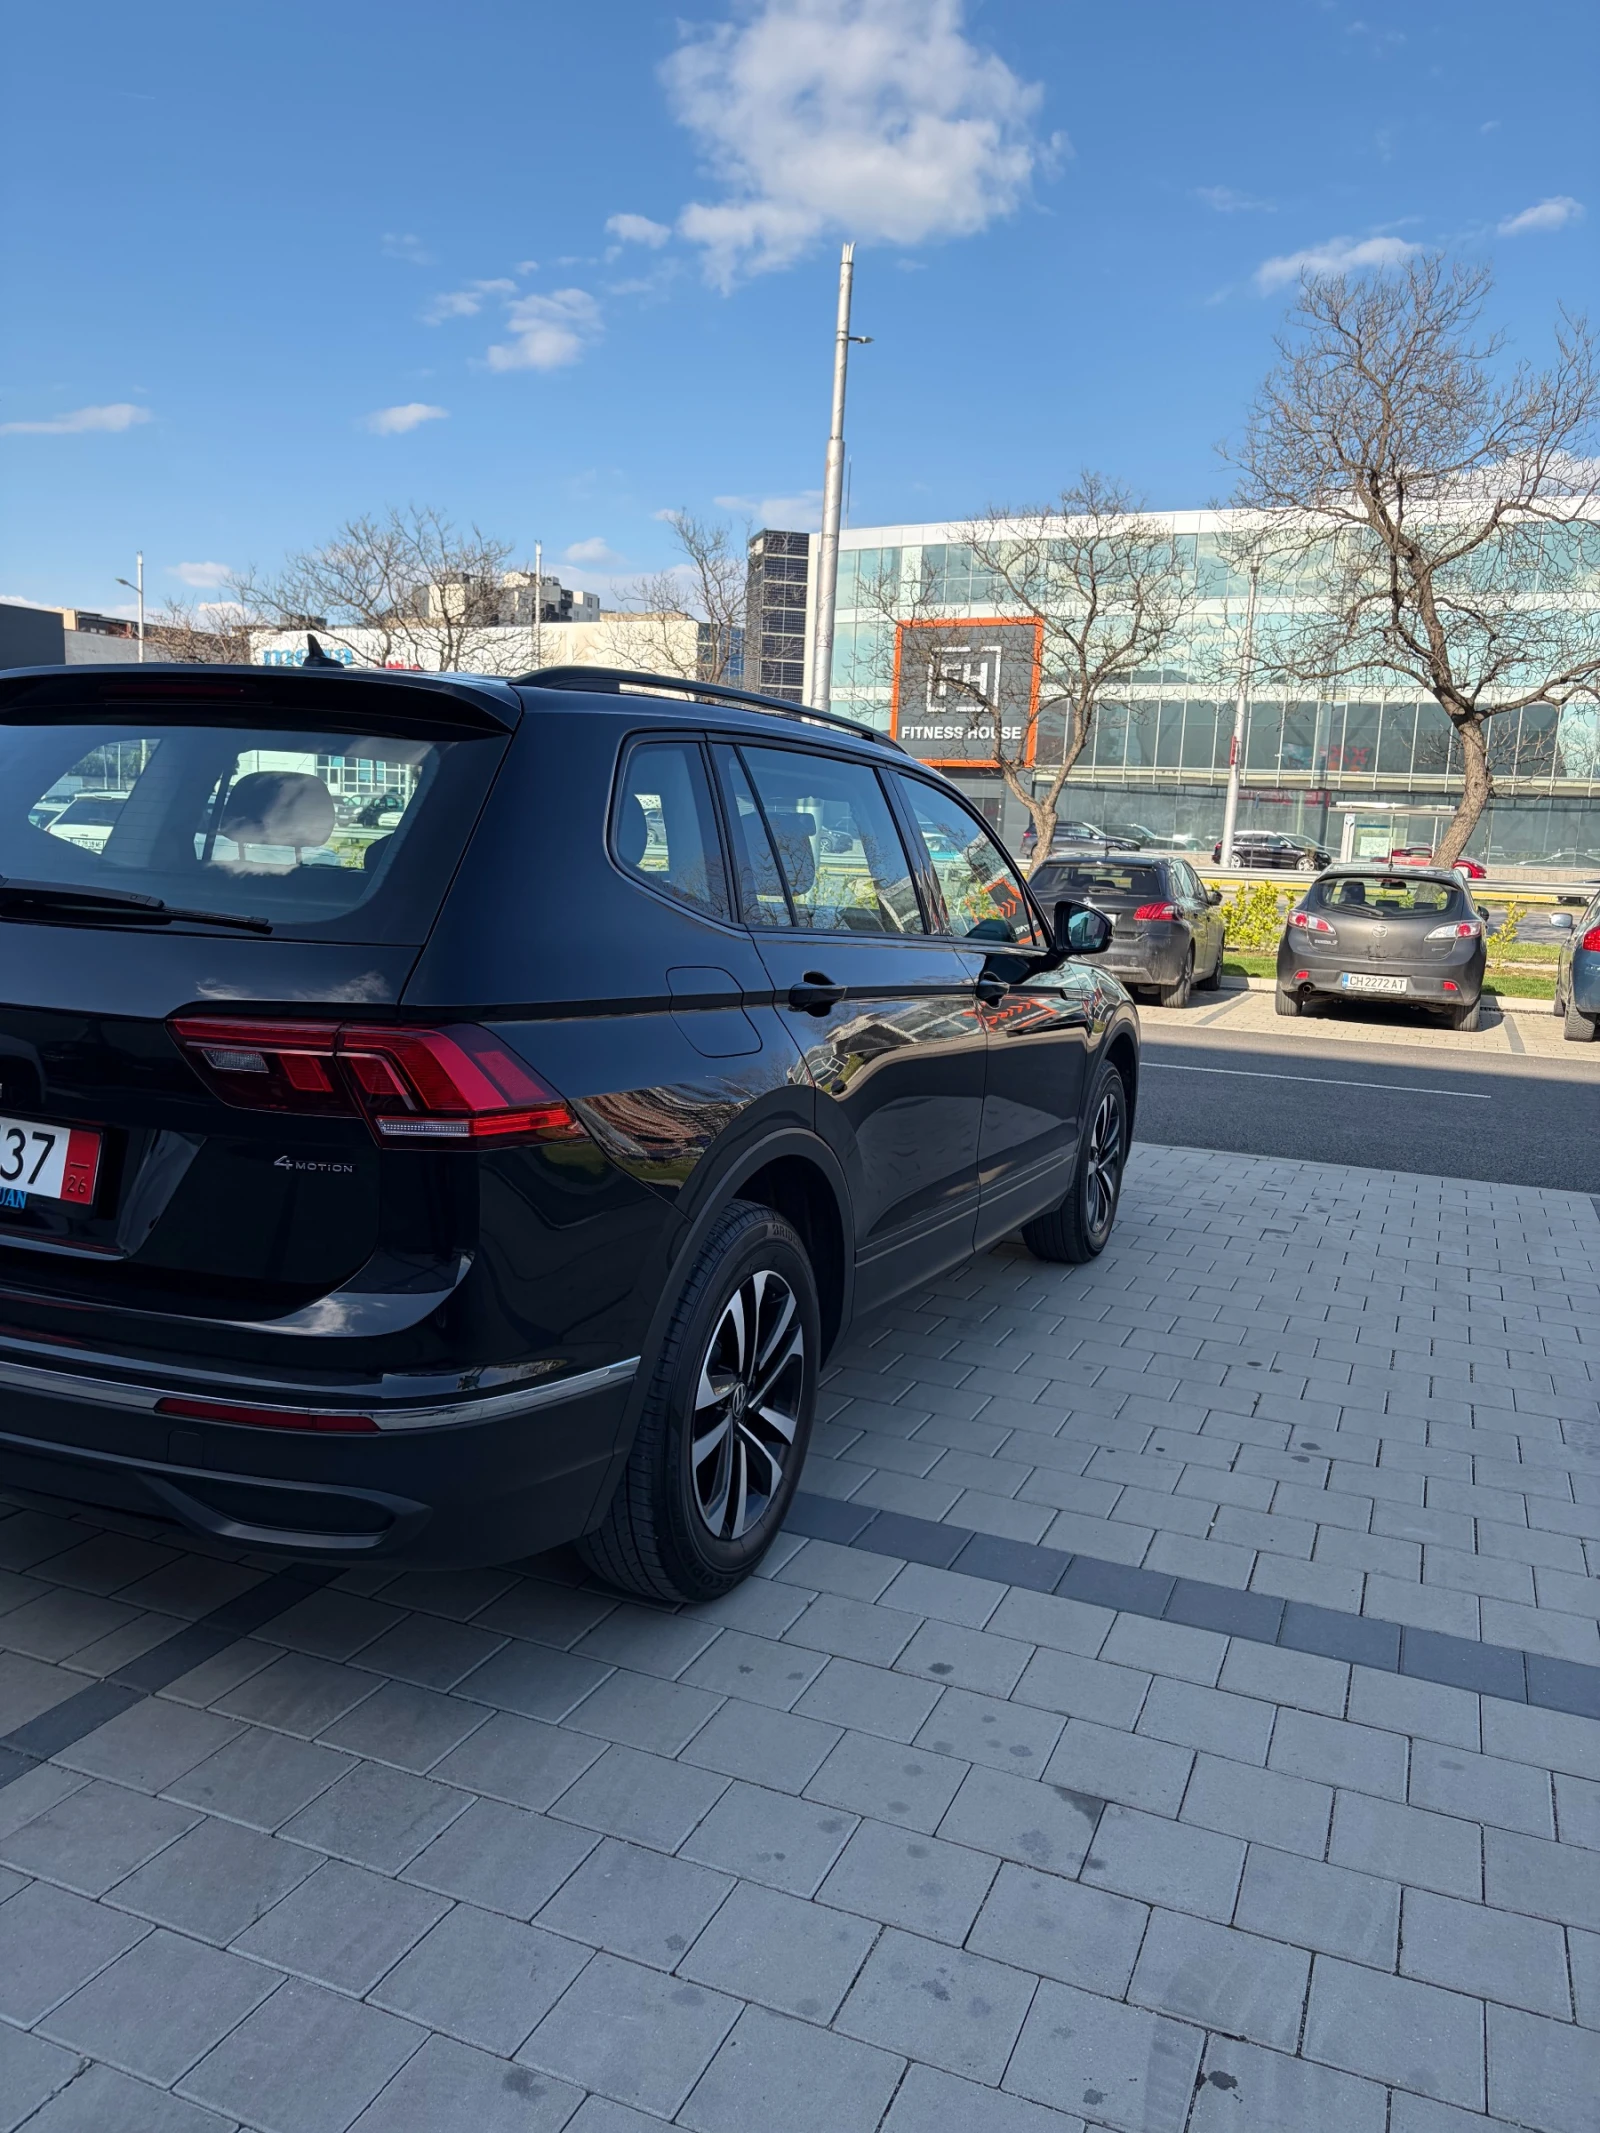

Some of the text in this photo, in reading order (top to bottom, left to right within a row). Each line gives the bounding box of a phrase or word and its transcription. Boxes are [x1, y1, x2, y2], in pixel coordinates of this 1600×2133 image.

[901, 726, 964, 740] FITNESS
[1350, 976, 1364, 986] CH
[1365, 977, 1390, 989] 2272
[1391, 979, 1405, 990] AT
[66, 1174, 88, 1194] 26
